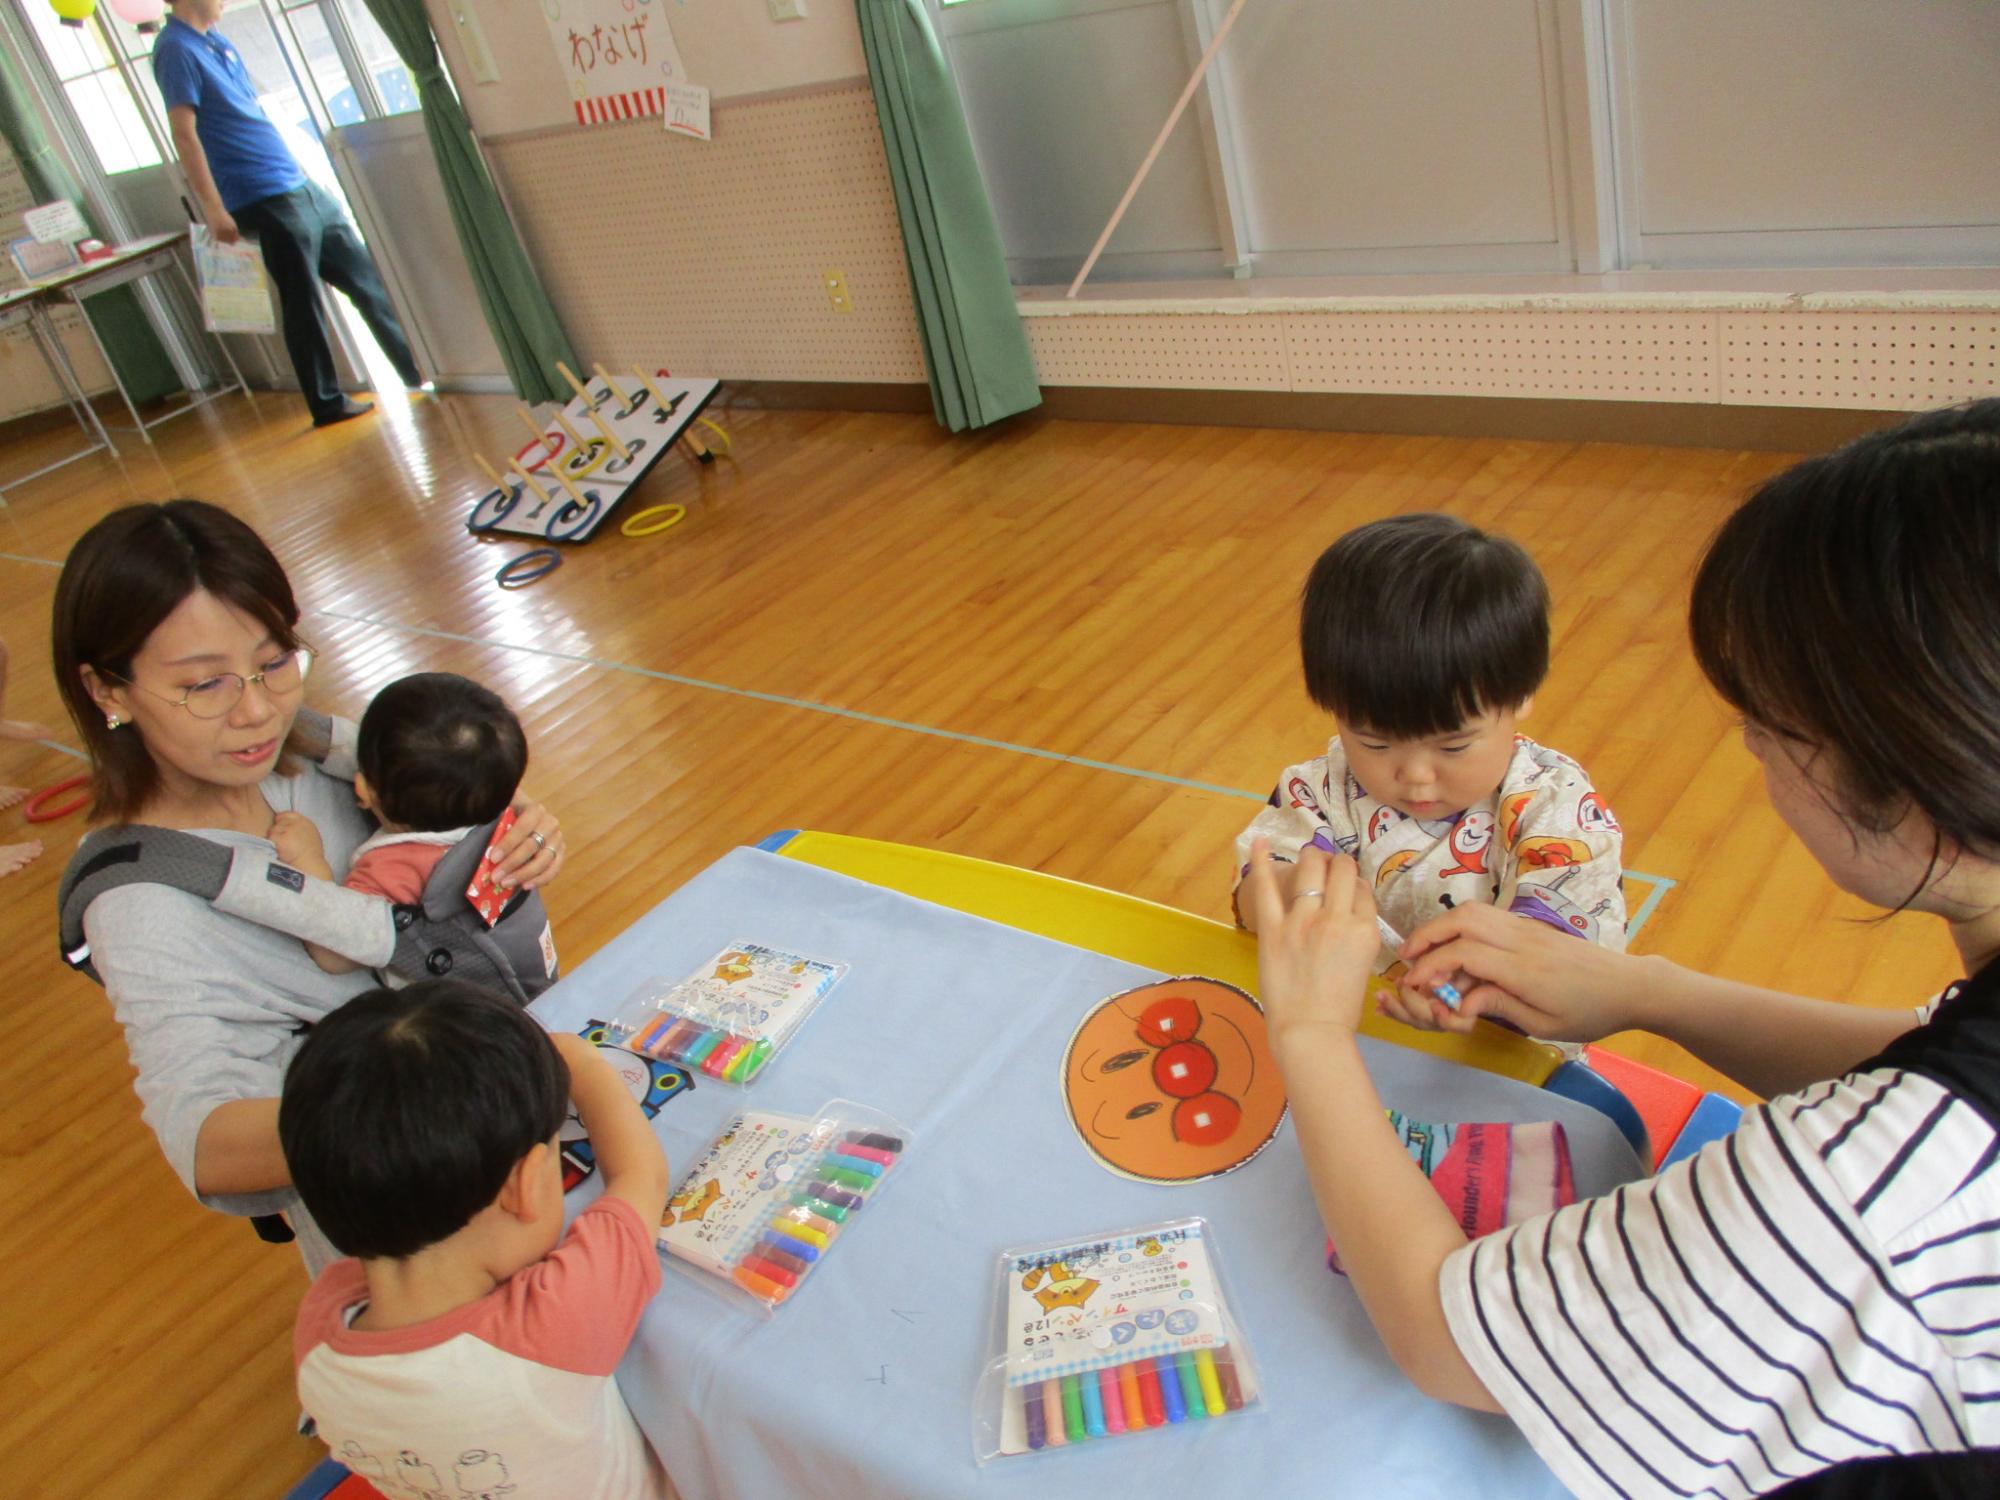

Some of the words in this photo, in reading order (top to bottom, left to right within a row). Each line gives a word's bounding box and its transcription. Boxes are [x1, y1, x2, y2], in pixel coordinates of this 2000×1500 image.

[568, 14, 648, 74] わなげ
[615, 388, 650, 421] 9
[653, 391, 690, 424] 4
